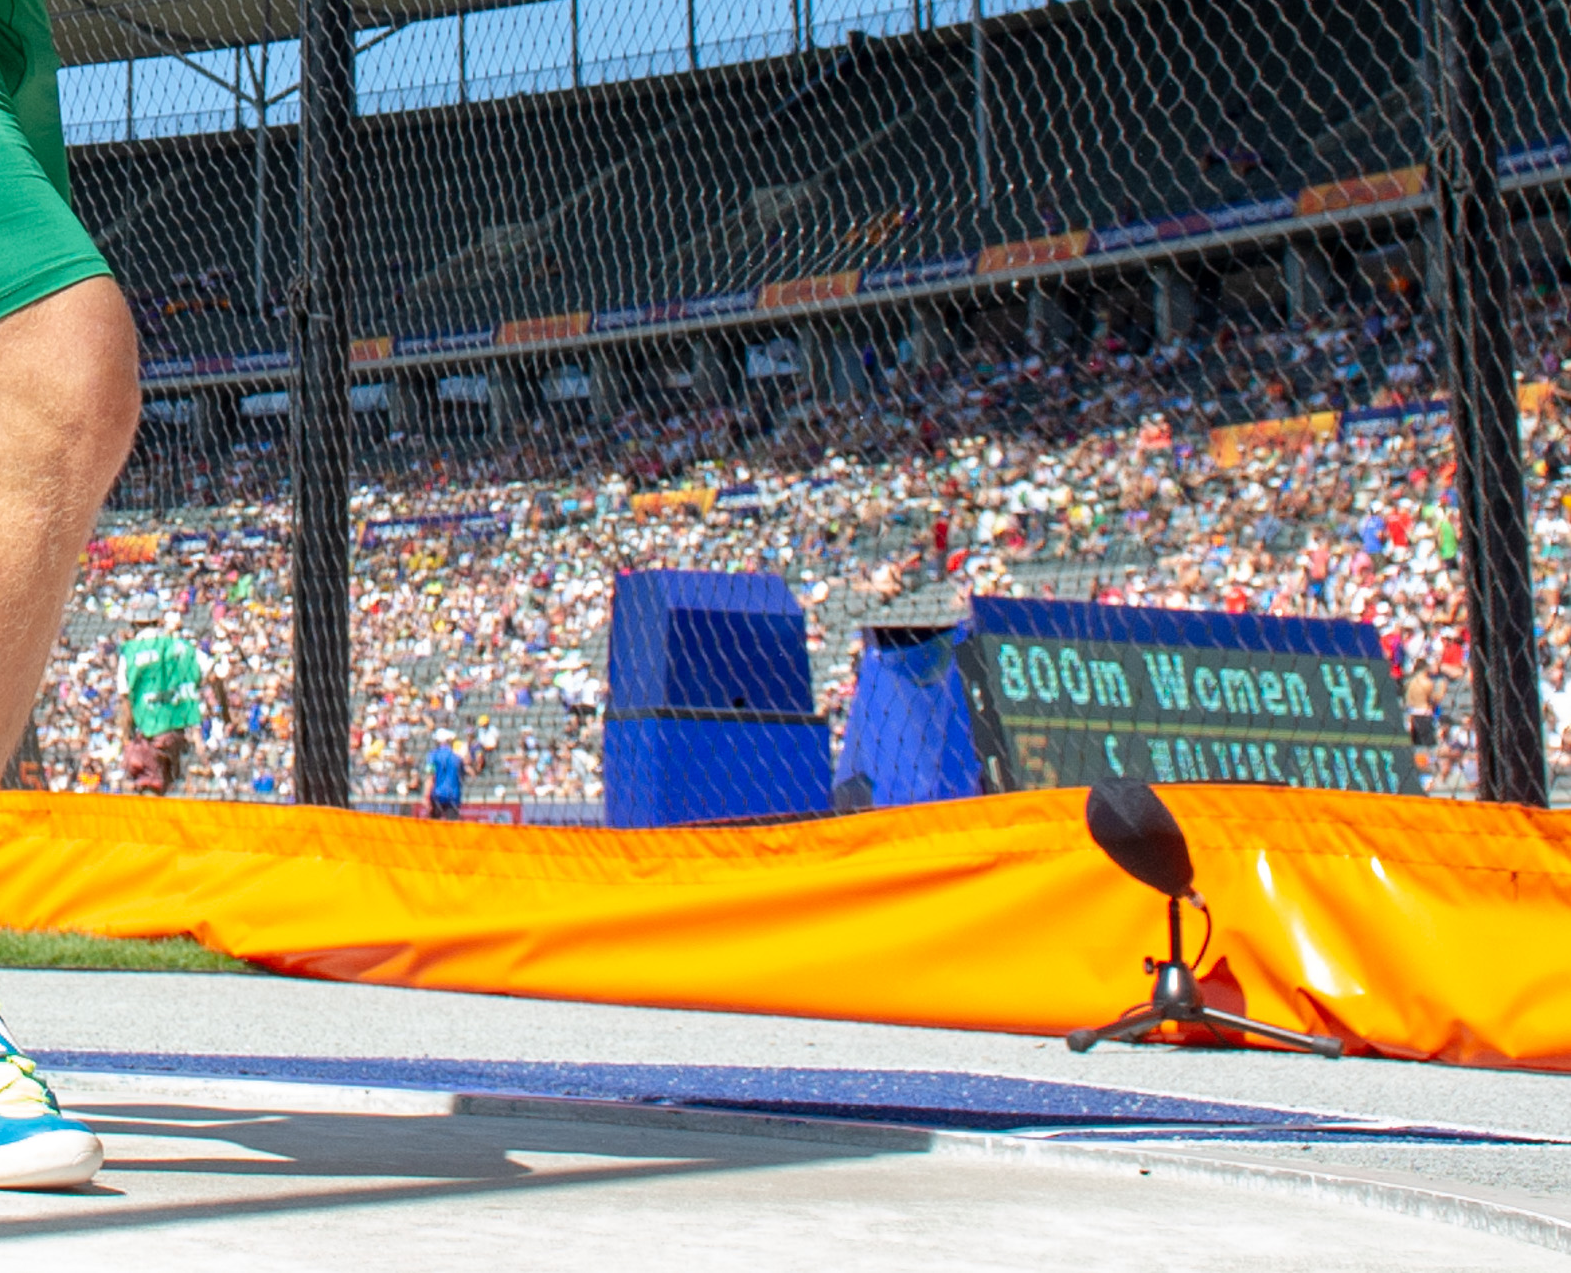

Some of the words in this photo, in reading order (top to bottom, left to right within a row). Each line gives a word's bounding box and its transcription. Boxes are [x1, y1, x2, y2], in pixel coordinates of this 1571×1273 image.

[997, 643, 1133, 708] 800m
[1142, 649, 1315, 719] Women
[1319, 662, 1386, 723] H2
